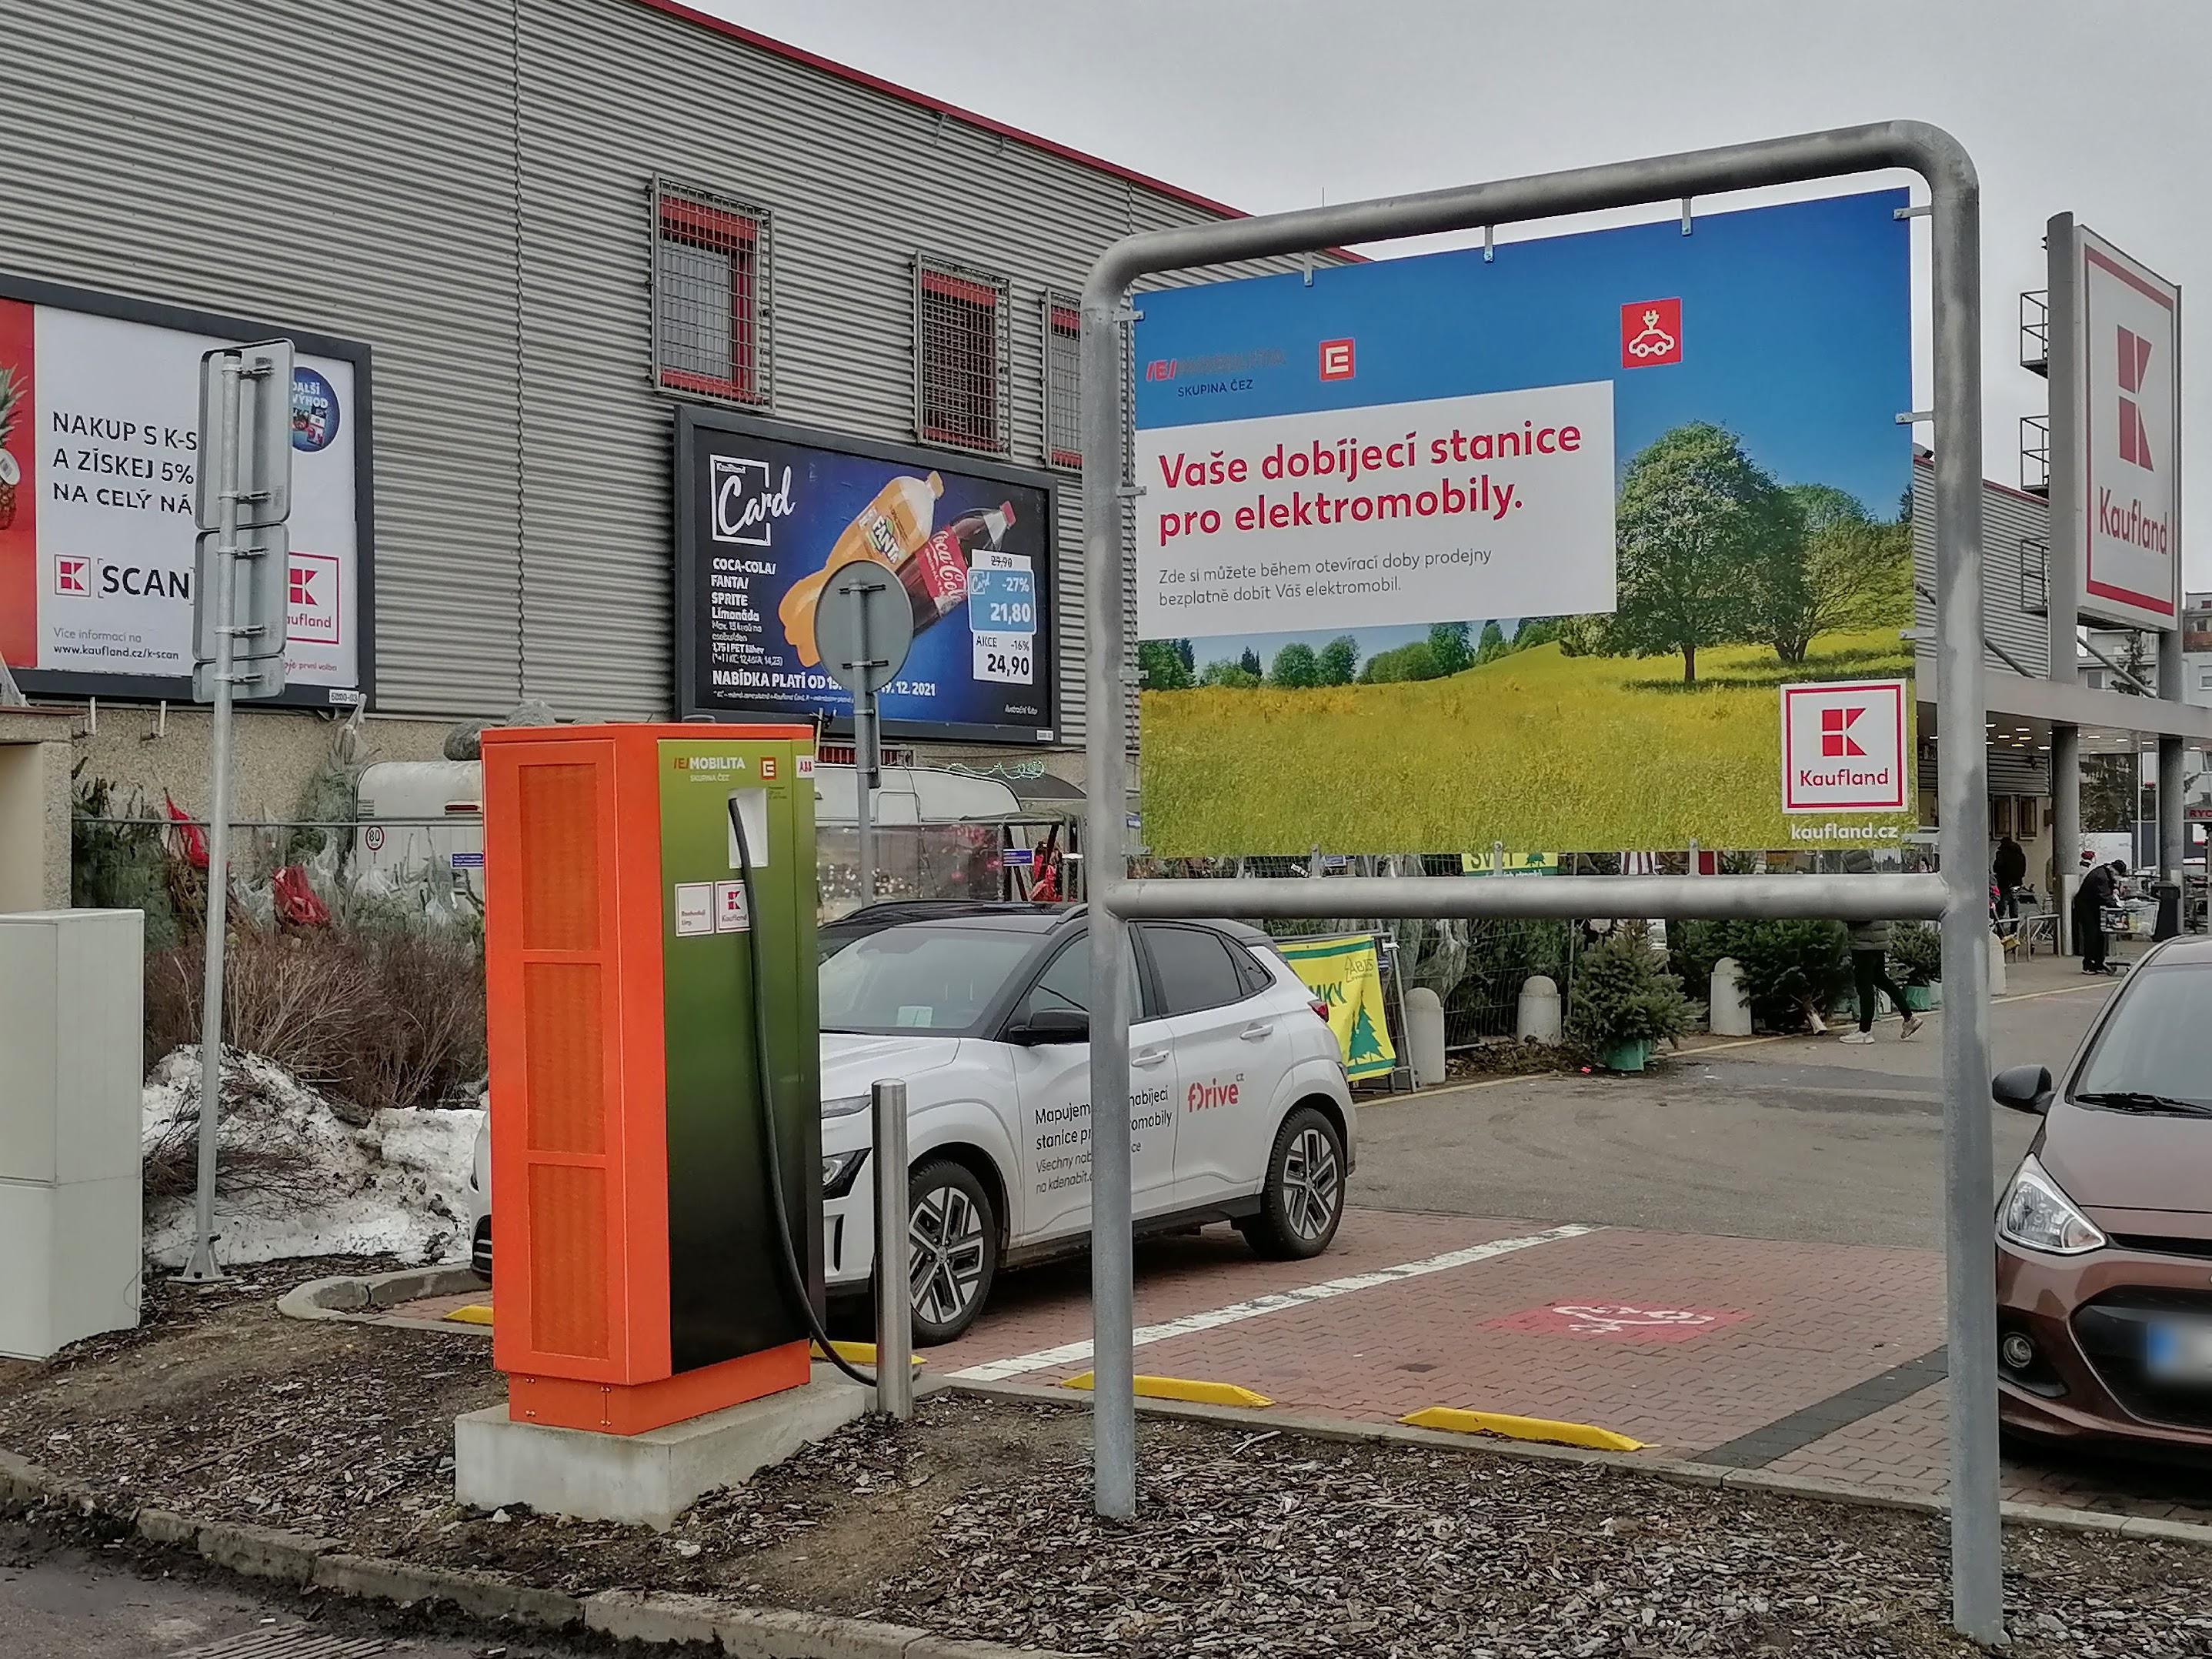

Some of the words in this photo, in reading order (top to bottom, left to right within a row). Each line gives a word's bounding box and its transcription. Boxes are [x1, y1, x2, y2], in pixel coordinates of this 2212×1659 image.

[1177, 382, 1227, 397] SKUPINA
[1230, 379, 1253, 391] ČEZ
[53, 411, 136, 441] NAKUP
[144, 426, 157, 445] S
[164, 428, 197, 451] K-S
[1158, 450, 1248, 488] Vaše
[1262, 431, 1416, 483] dobíjecí
[1430, 420, 1581, 464] stanice
[52, 448, 69, 469] A
[78, 448, 153, 479] ZÍSKEJ
[161, 462, 194, 484] 5%
[53, 482, 88, 503] NA
[96, 488, 152, 509] CELÝ
[160, 493, 192, 516] NÁ
[718, 466, 796, 535] Card
[1160, 509, 1221, 546] pro
[1235, 474, 1523, 530] elektromobily.
[2100, 486, 2167, 555] Kaufland
[872, 516, 899, 564] FANTA
[712, 558, 776, 574] COCA-COLA/
[1159, 569, 1186, 584] Zde
[1189, 568, 1199, 582] si
[1204, 566, 1256, 582] můžete
[1260, 562, 1310, 577] během
[1315, 555, 1378, 573] otevírací
[1383, 552, 1420, 570] doby
[1425, 549, 1492, 569] prodejny
[102, 565, 189, 599] SCAN
[710, 575, 749, 589] FANTA/
[1002, 577, 1029, 592] -27%
[1159, 589, 1229, 608] bezplatně
[1233, 586, 1271, 602] dobít
[1275, 583, 1301, 598] Váš
[1306, 576, 1401, 597] elektromobil.
[711, 592, 749, 606] SPRITE
[712, 606, 759, 622] Limonáda
[990, 603, 1031, 625] 21,80
[53, 627, 76, 639] Více
[78, 629, 126, 642] informací
[129, 634, 142, 643] na
[976, 636, 998, 647] AKCE
[1010, 639, 1029, 652] -16%
[53, 644, 179, 660] www.kaufland.cz/k-scan
[987, 653, 1029, 676] 24,90
[712, 669, 769, 687] NABÍDKA
[772, 672, 806, 689] PLATÍ
[808, 675, 826, 689] OD
[912, 682, 936, 696] 2021
[1800, 768, 1889, 786] Kaufland
[1791, 823, 1898, 840] kaufland.cz
[1036, 1102, 1091, 1125] Mapujem
[1036, 1128, 1078, 1150] stanice
[1131, 1110, 1173, 1131] omobily
[1036, 1157, 1074, 1173] Všechny
[1036, 1182, 1046, 1194] na
